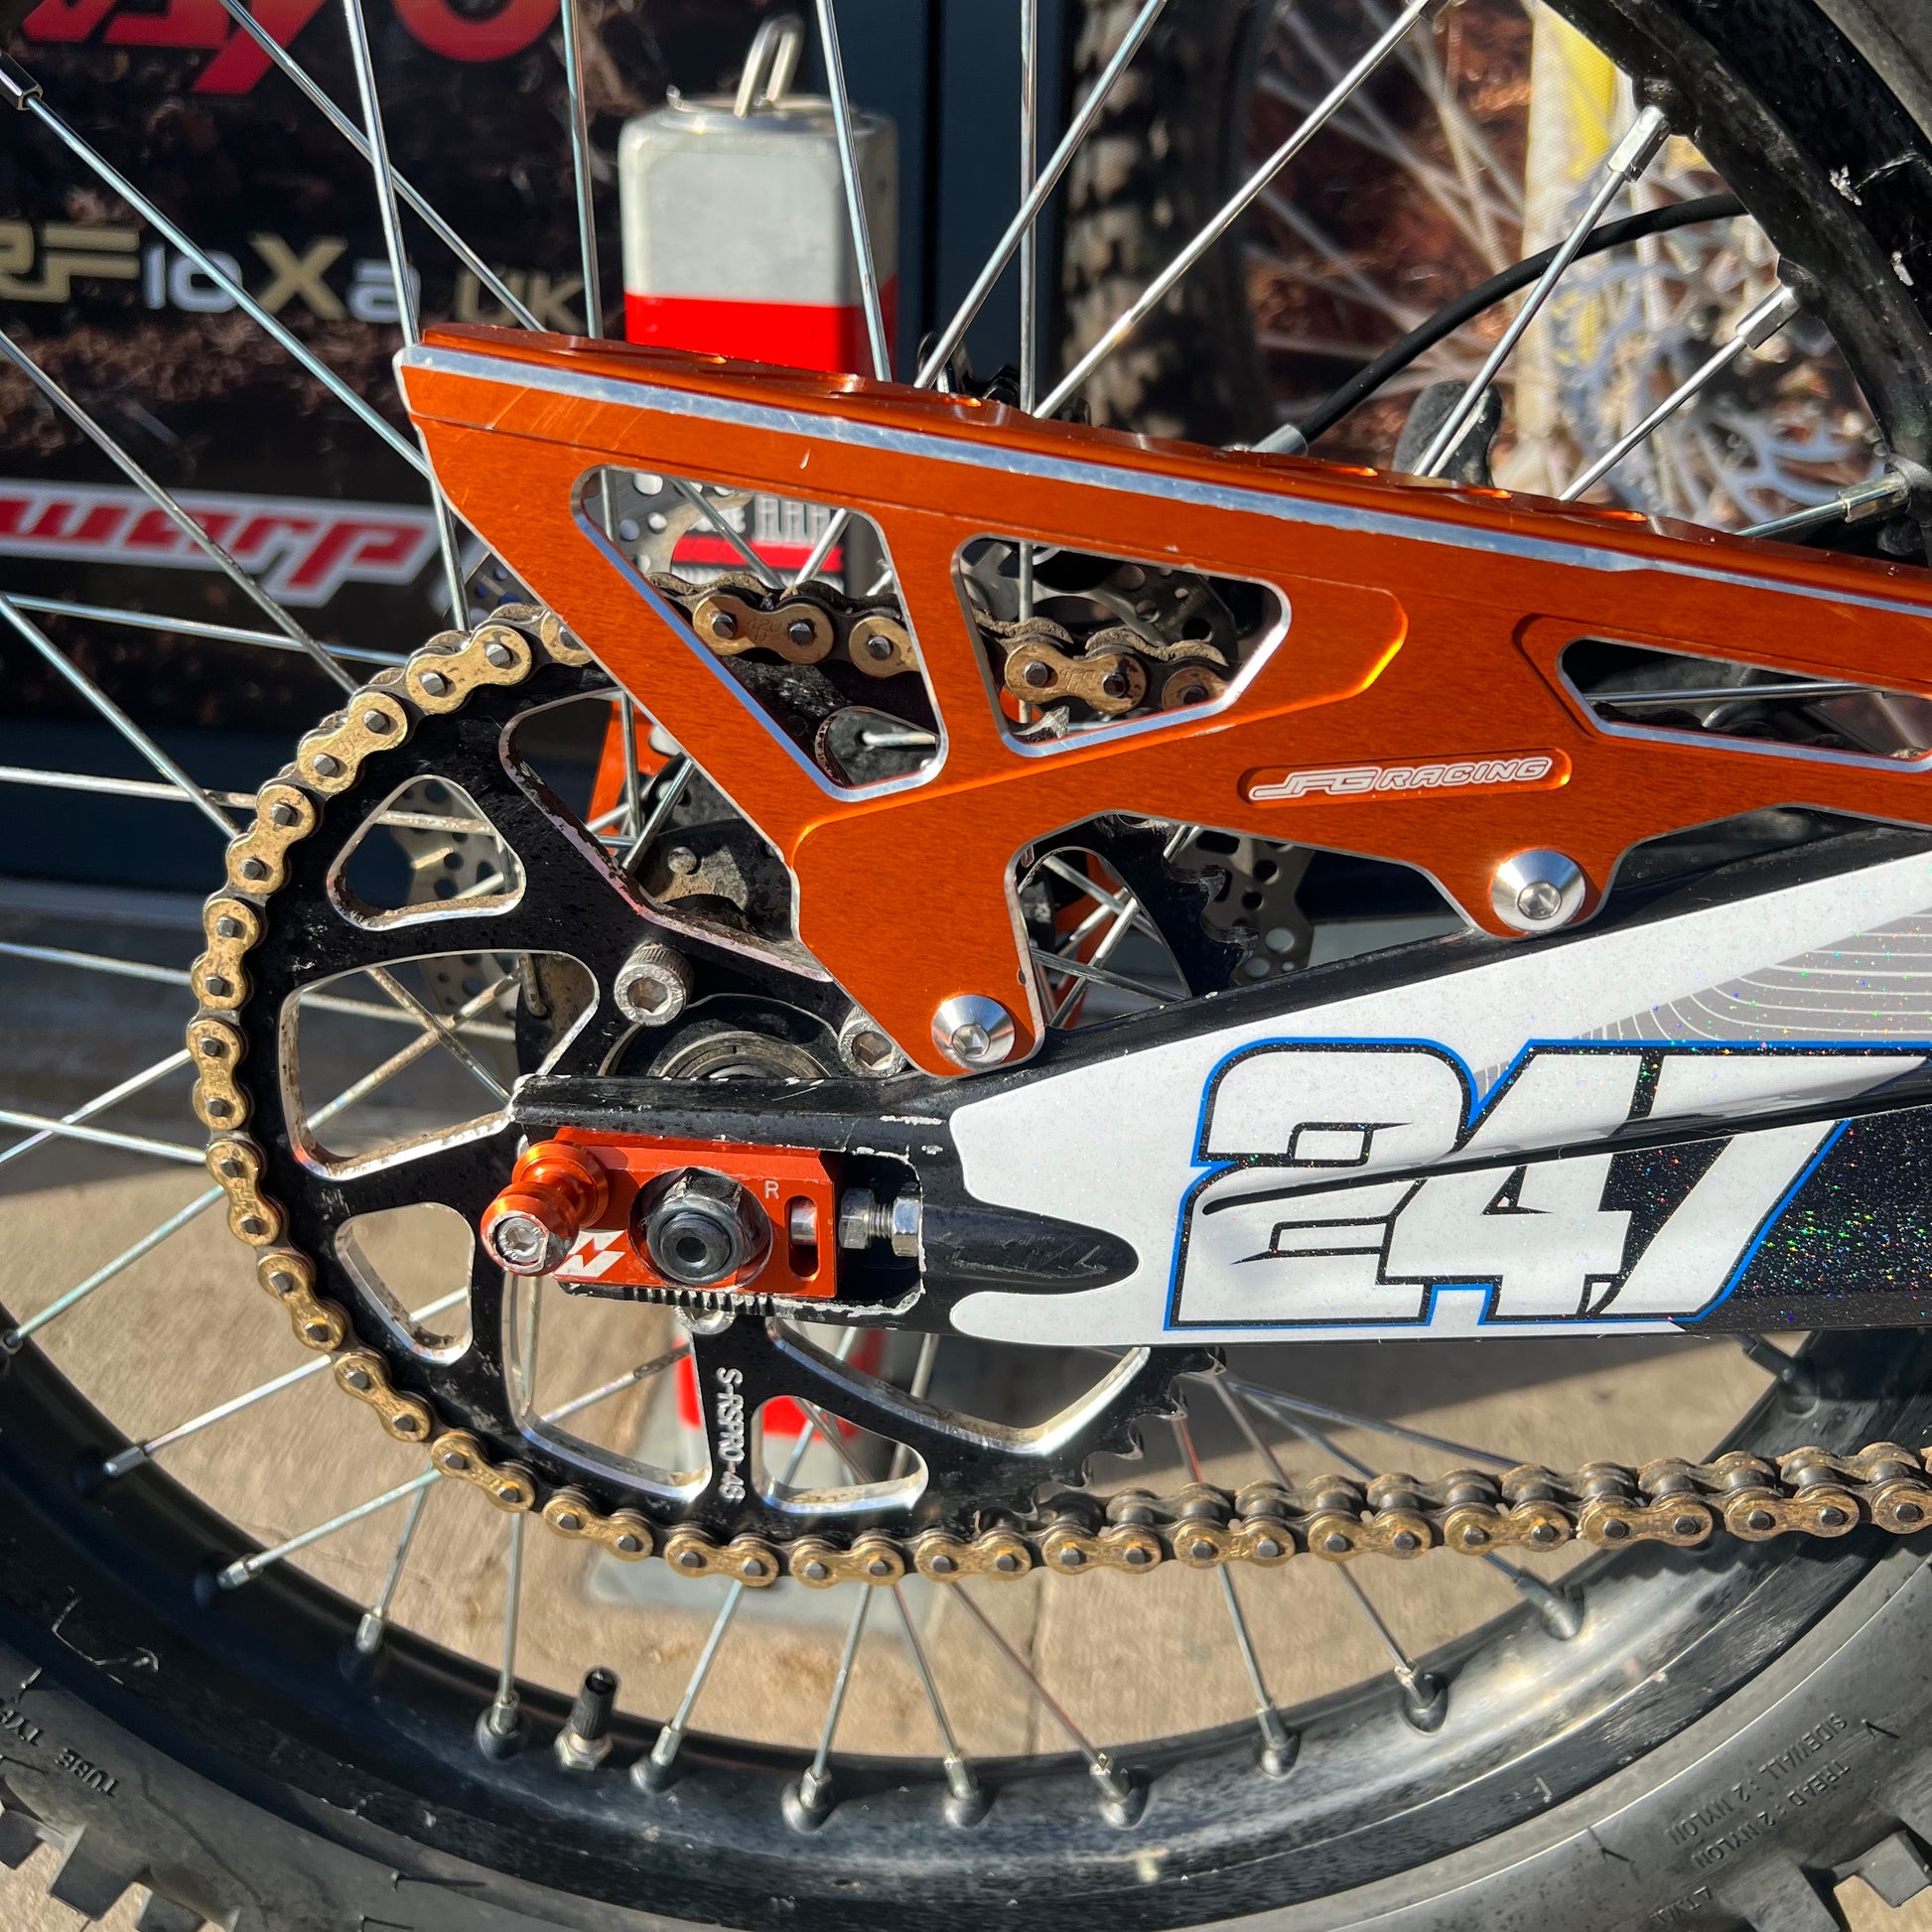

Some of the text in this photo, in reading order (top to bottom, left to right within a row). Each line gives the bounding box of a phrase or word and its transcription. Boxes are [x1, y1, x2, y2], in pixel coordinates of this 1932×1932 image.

[455, 266, 584, 334] UK
[1376, 757, 1553, 792] RACING
[764, 1180, 779, 1199] R
[1164, 1038, 1928, 1330] 247
[1758, 1713, 1848, 1780] SIDEWALL
[54, 1747, 119, 1798] TUBE
[1787, 1758, 1852, 1807] TREAD
[1666, 1794, 1735, 1846] NYLON
[1691, 1821, 1761, 1869] NYLON
